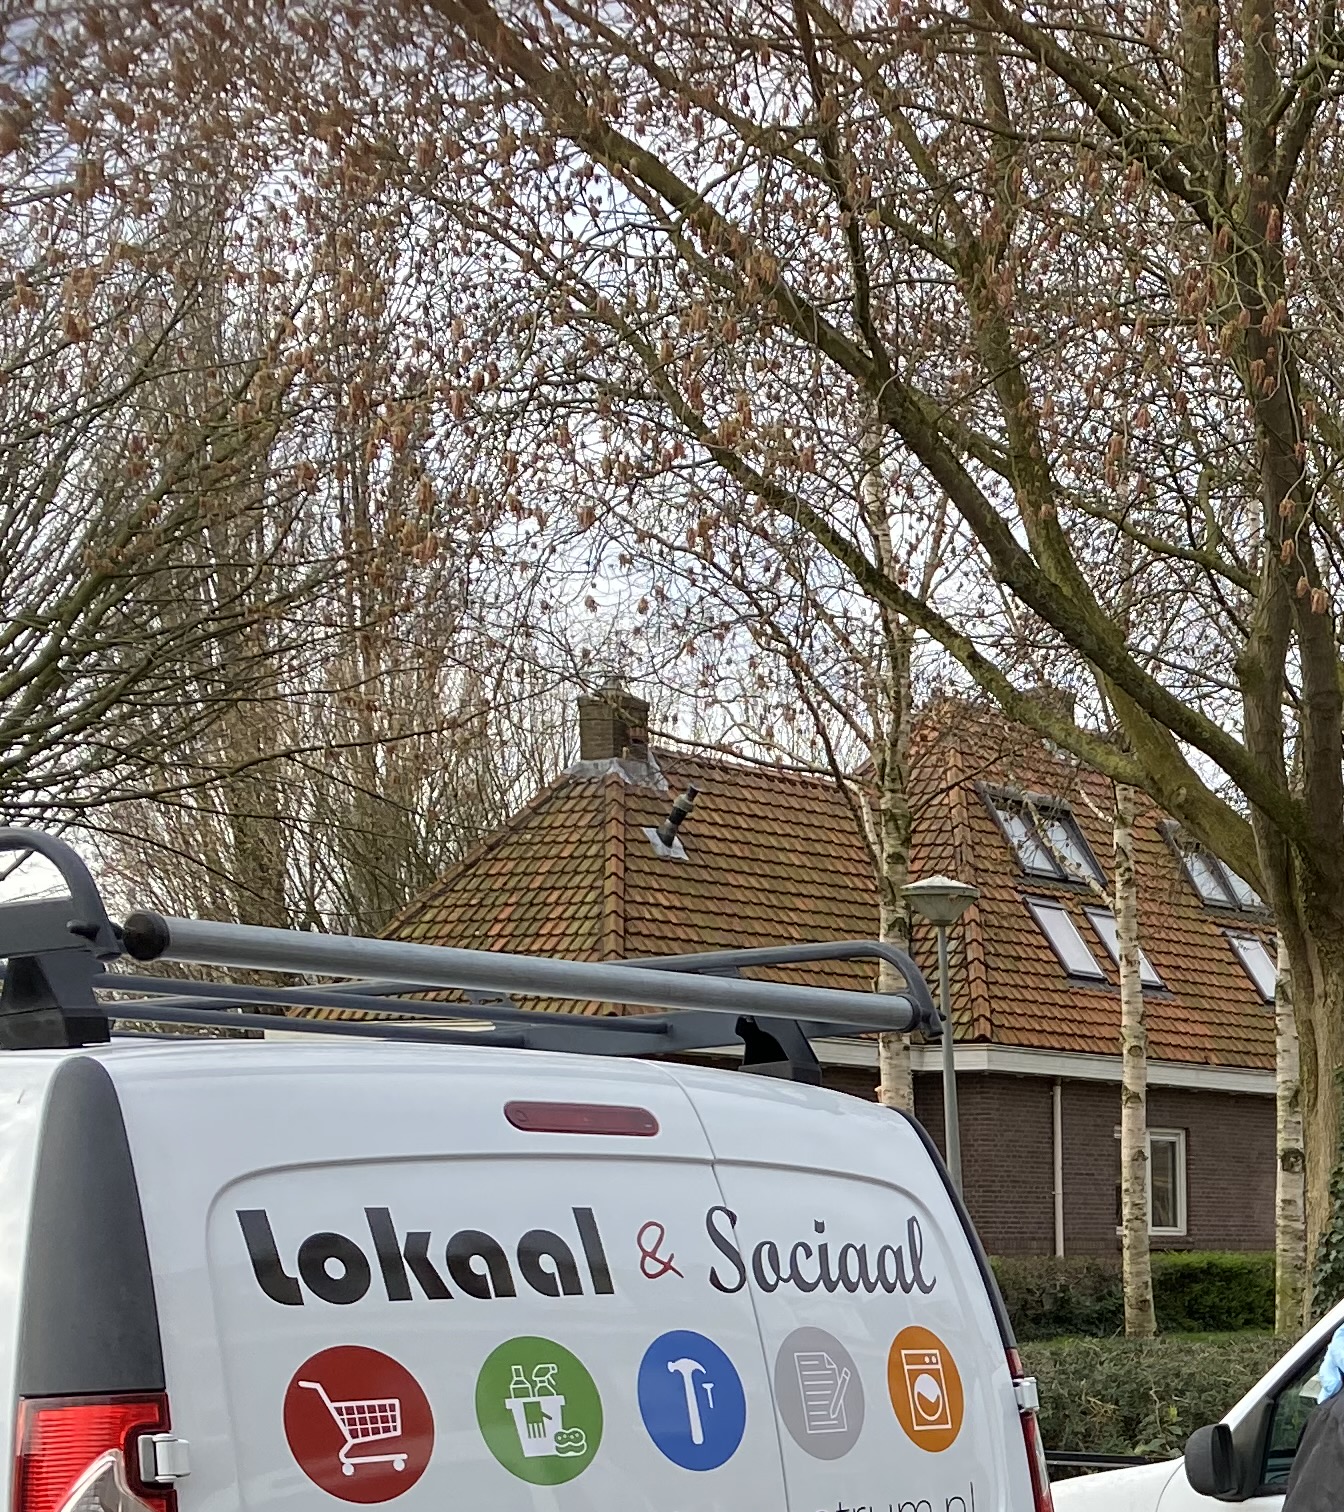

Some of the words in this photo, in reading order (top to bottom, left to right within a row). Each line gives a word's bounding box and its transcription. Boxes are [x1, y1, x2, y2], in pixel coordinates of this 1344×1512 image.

[234, 1206, 616, 1307] Lokaal
[636, 1221, 684, 1280] &
[705, 1206, 937, 1295] Sociaal
